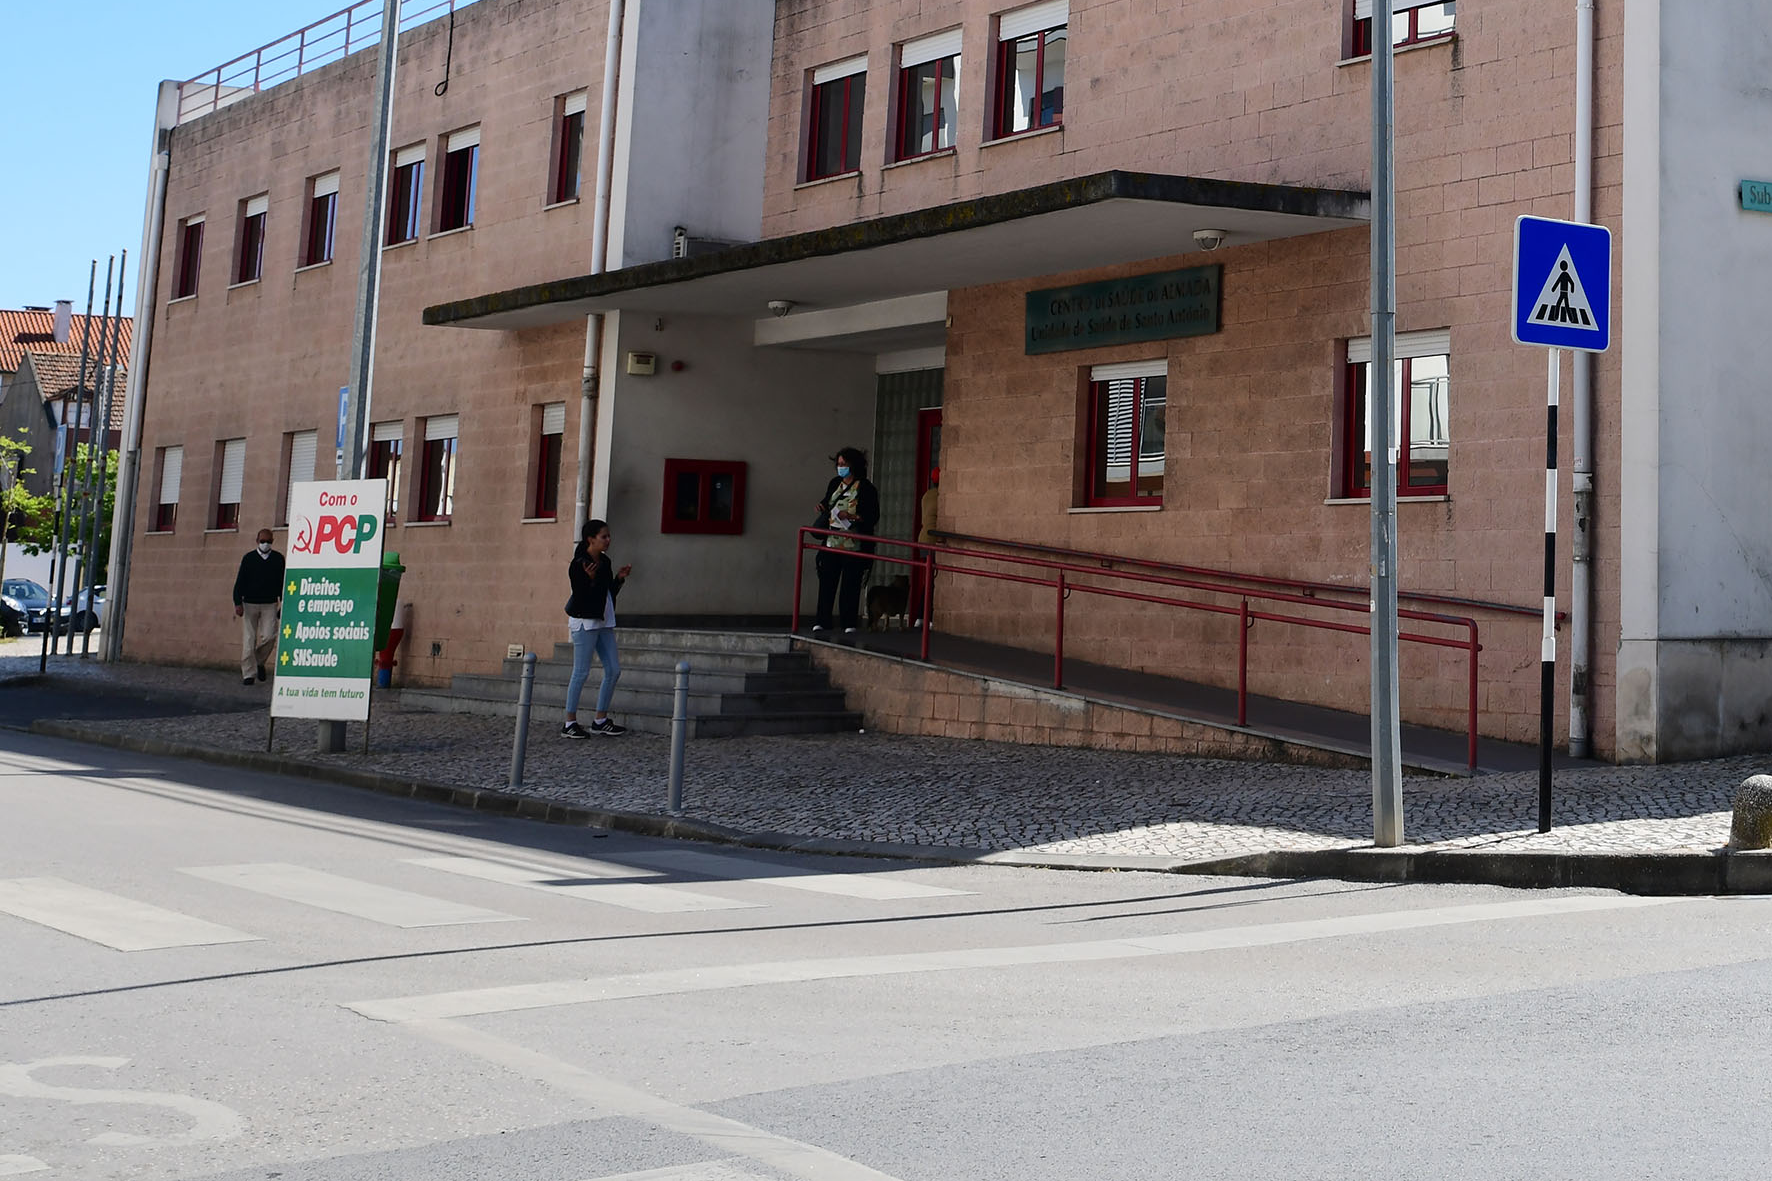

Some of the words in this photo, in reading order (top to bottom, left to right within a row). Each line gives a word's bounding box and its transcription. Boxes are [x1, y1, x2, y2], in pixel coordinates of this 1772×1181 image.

[319, 491, 347, 507] Com
[350, 494, 358, 506] o
[312, 514, 378, 554] PCP
[300, 576, 341, 596] Direitos
[298, 599, 305, 612] e
[307, 599, 354, 616] emprego
[295, 620, 331, 643] Apoios
[332, 621, 370, 640] sociais
[292, 648, 338, 667] SNSaúde
[278, 686, 284, 696] A
[286, 687, 299, 697] tua
[302, 686, 318, 698] vida
[321, 688, 337, 698] tem
[339, 688, 365, 699] futuro
